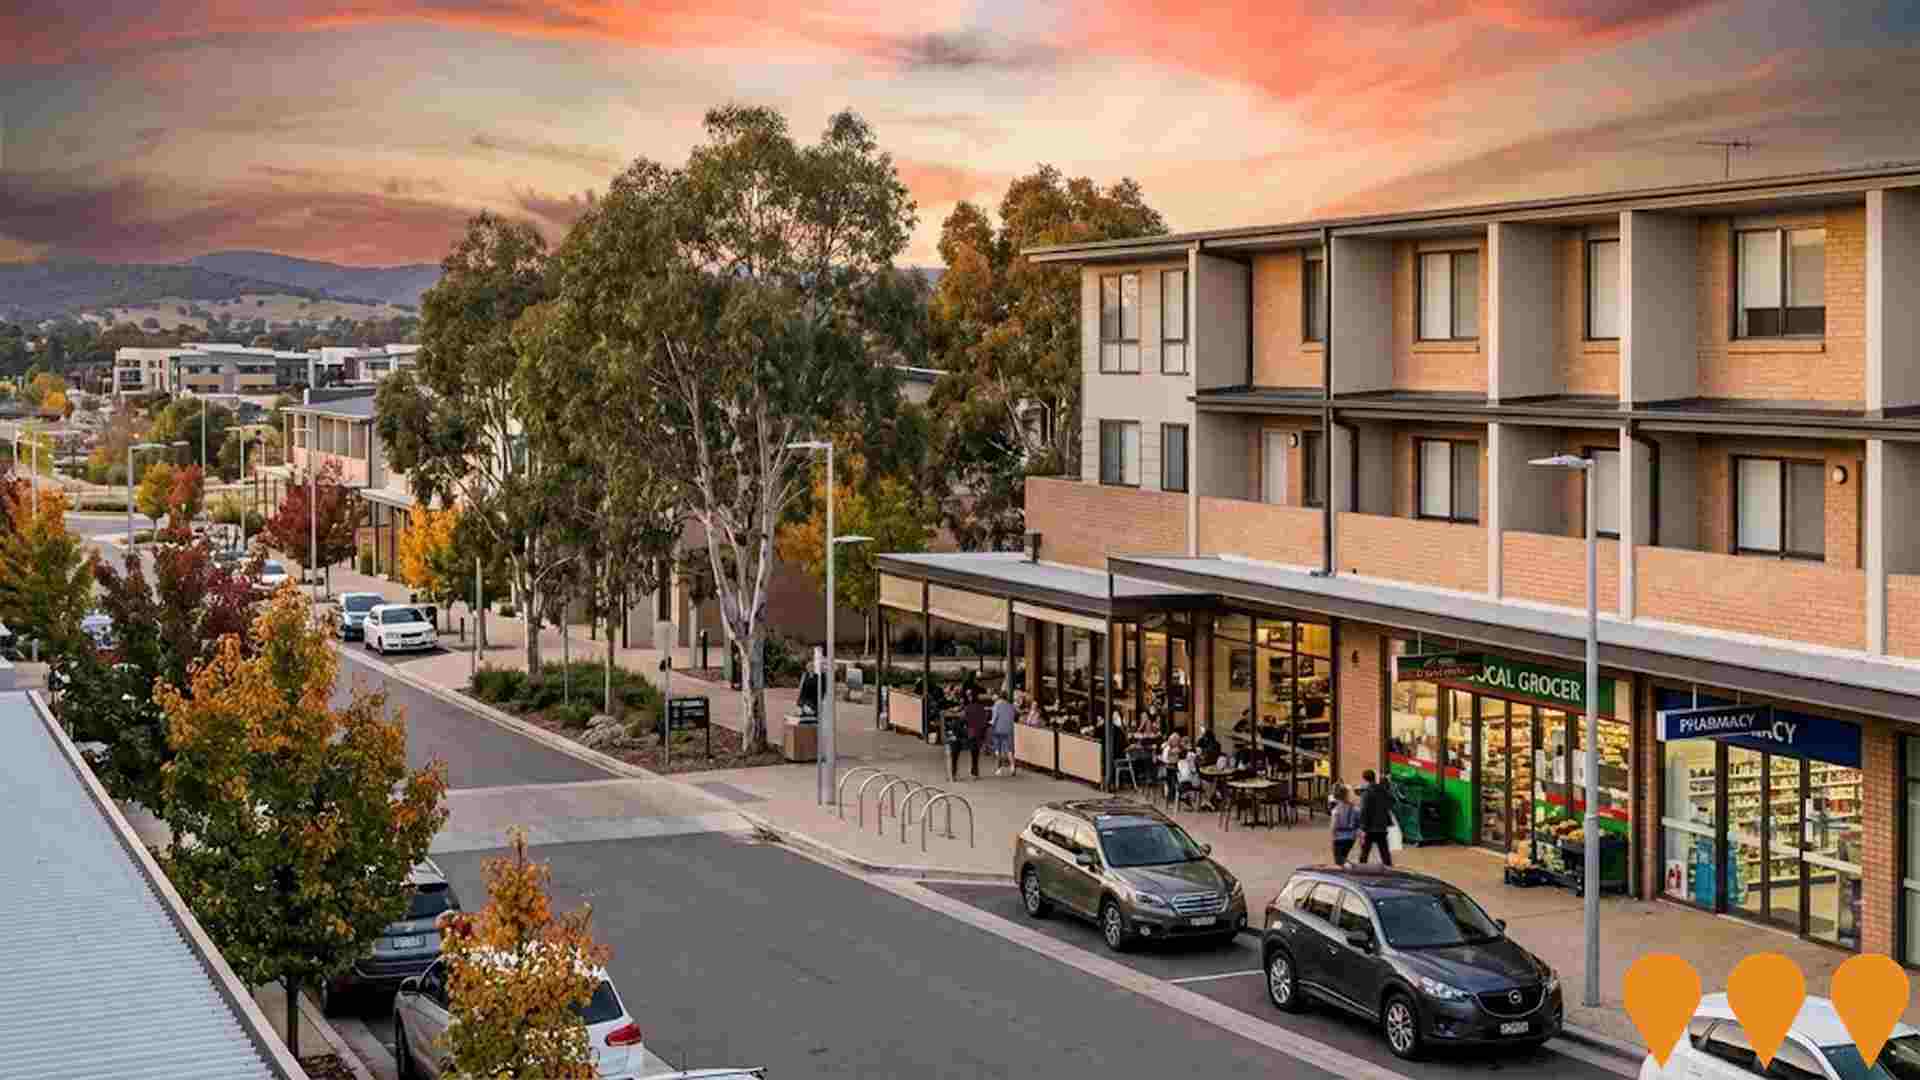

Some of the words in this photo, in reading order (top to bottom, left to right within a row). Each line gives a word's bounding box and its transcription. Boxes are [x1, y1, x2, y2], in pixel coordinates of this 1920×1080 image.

[1466, 665, 1515, 689] OCAL
[1518, 671, 1581, 701] GROCER
[1679, 713, 1755, 733] PHARMACY
